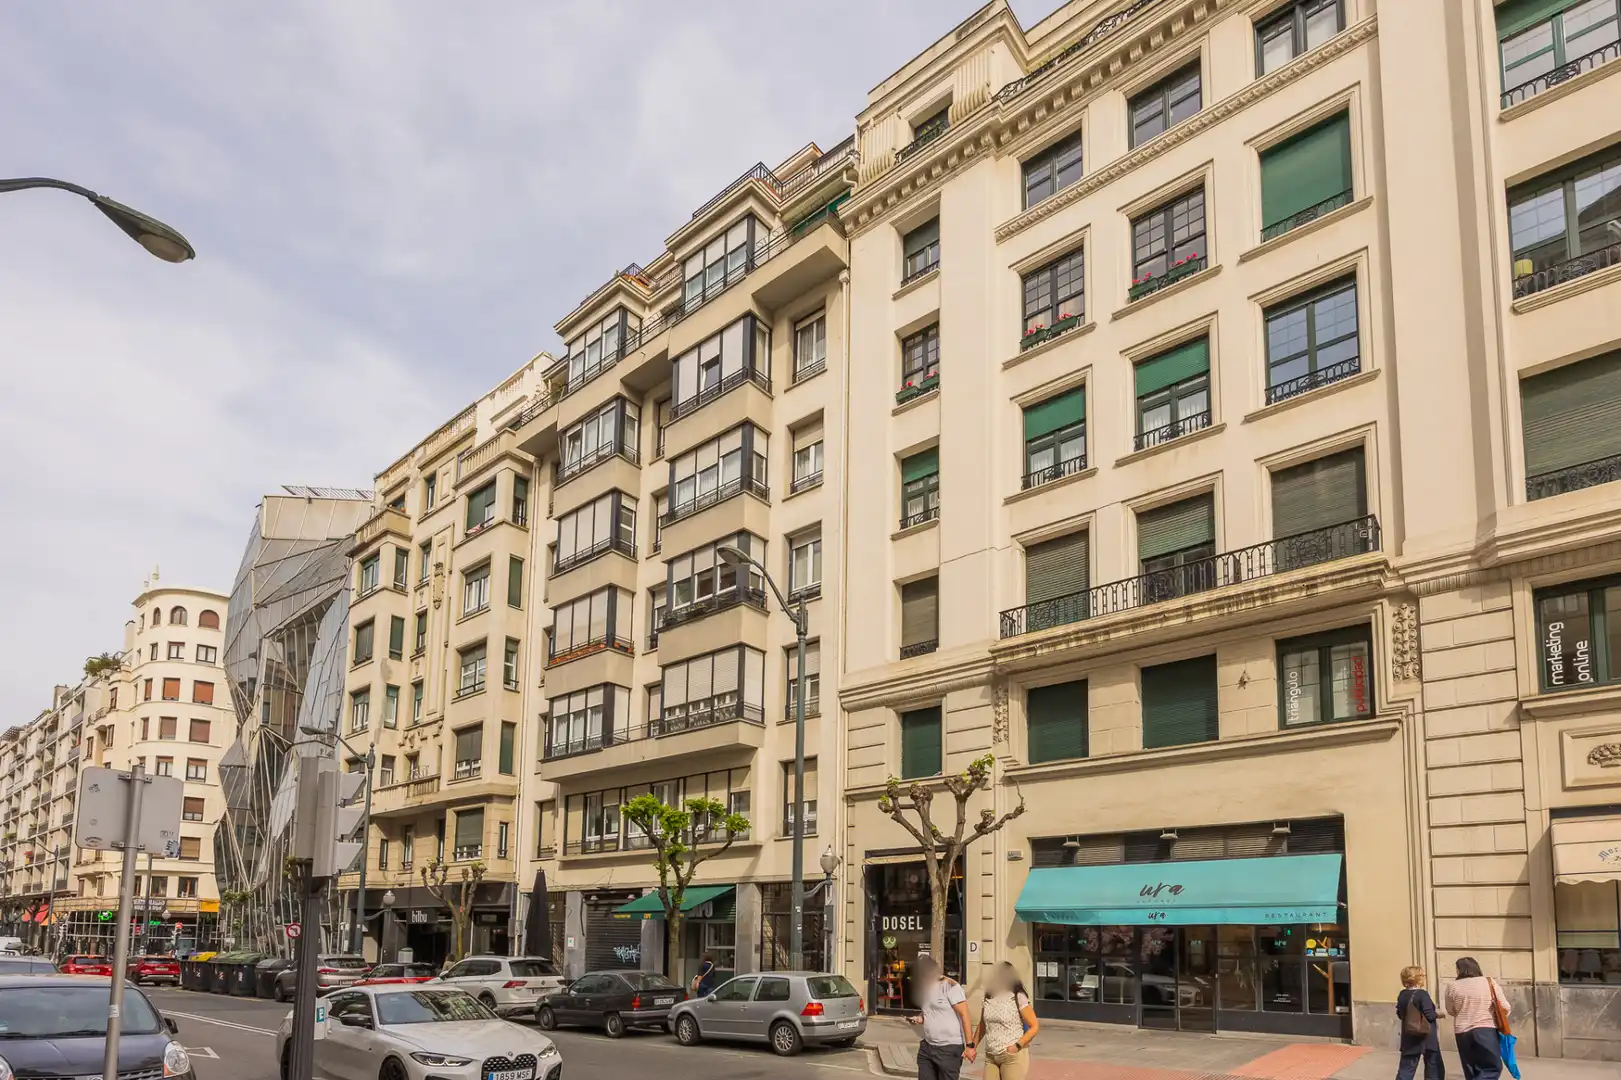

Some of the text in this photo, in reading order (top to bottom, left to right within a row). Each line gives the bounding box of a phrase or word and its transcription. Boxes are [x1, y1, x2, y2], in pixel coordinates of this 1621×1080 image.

[1546, 621, 1565, 685] marketing
[1573, 640, 1591, 681] online
[1286, 671, 1301, 721] triangulo
[1139, 882, 1186, 898] ura
[882, 916, 923, 930] DOSEL
[1147, 911, 1167, 920] ura
[970, 942, 977, 952] D
